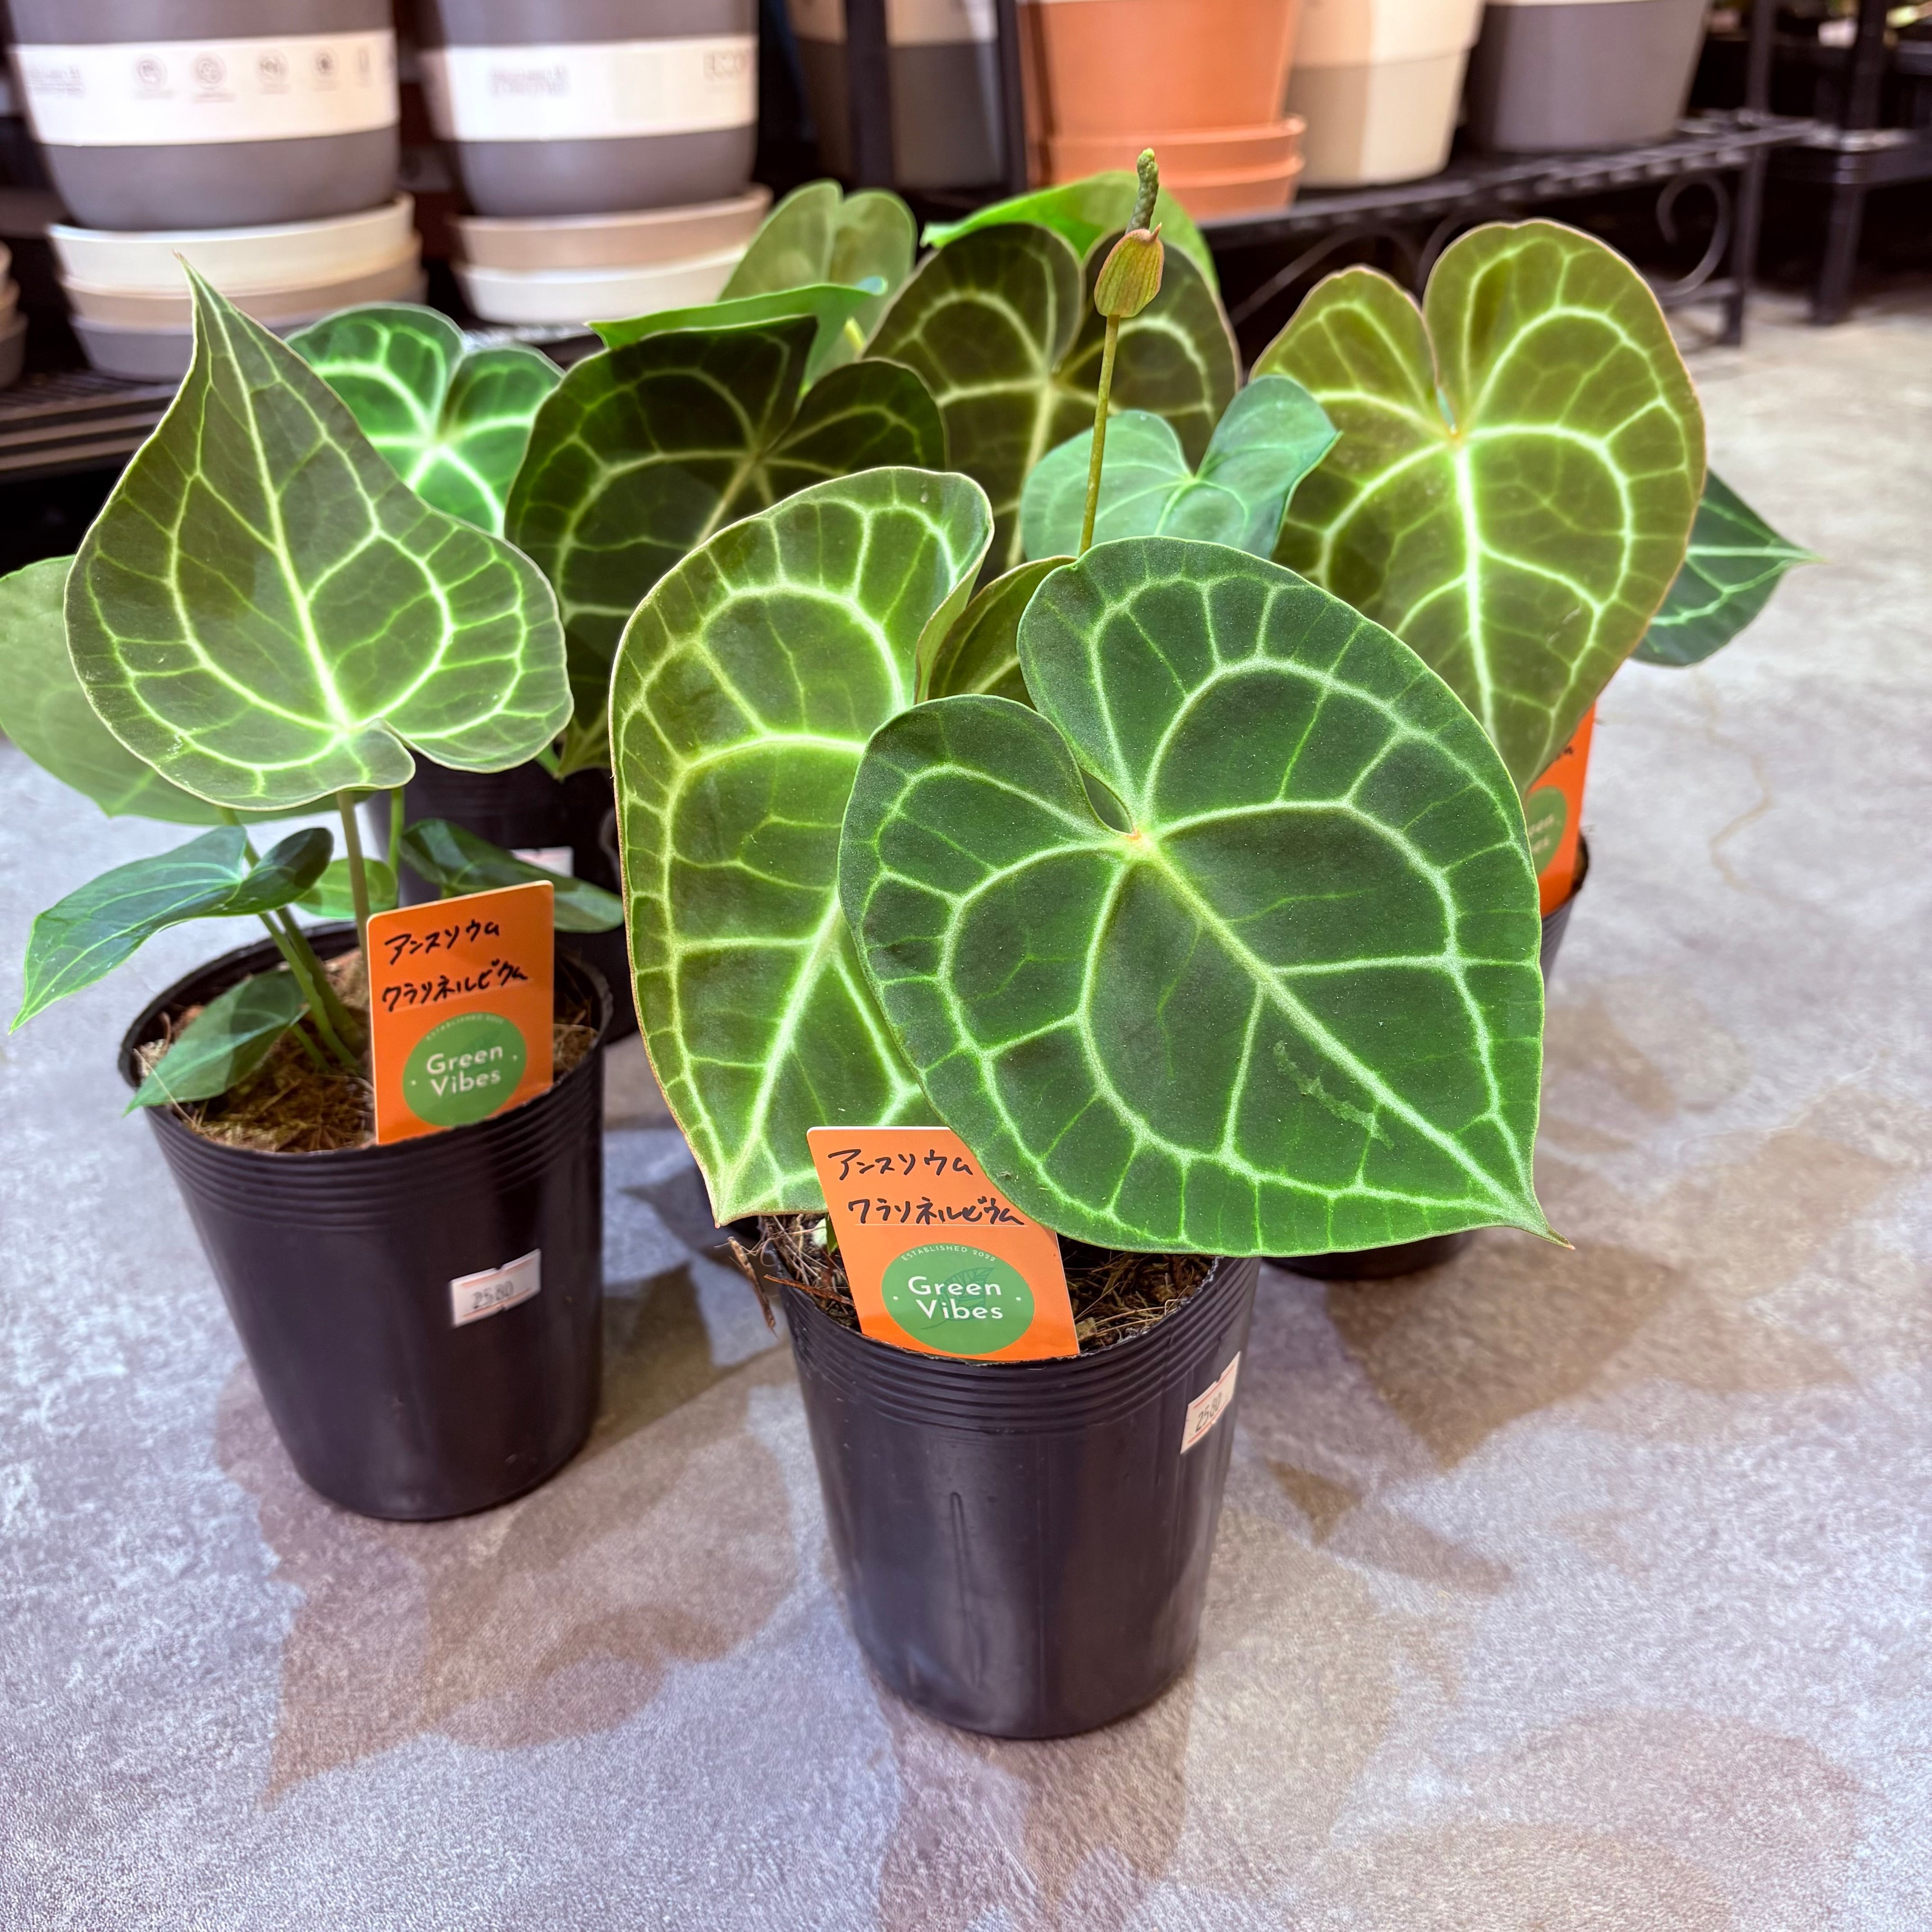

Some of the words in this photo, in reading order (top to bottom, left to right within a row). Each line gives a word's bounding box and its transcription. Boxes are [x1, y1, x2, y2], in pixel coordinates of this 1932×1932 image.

[427, 1045, 503, 1075] Green
[431, 1068, 501, 1097] Vibes
[902, 1245, 967, 1261] ESTABLISHED
[908, 1276, 1002, 1296] Green
[916, 1298, 1003, 1320] Vibes
